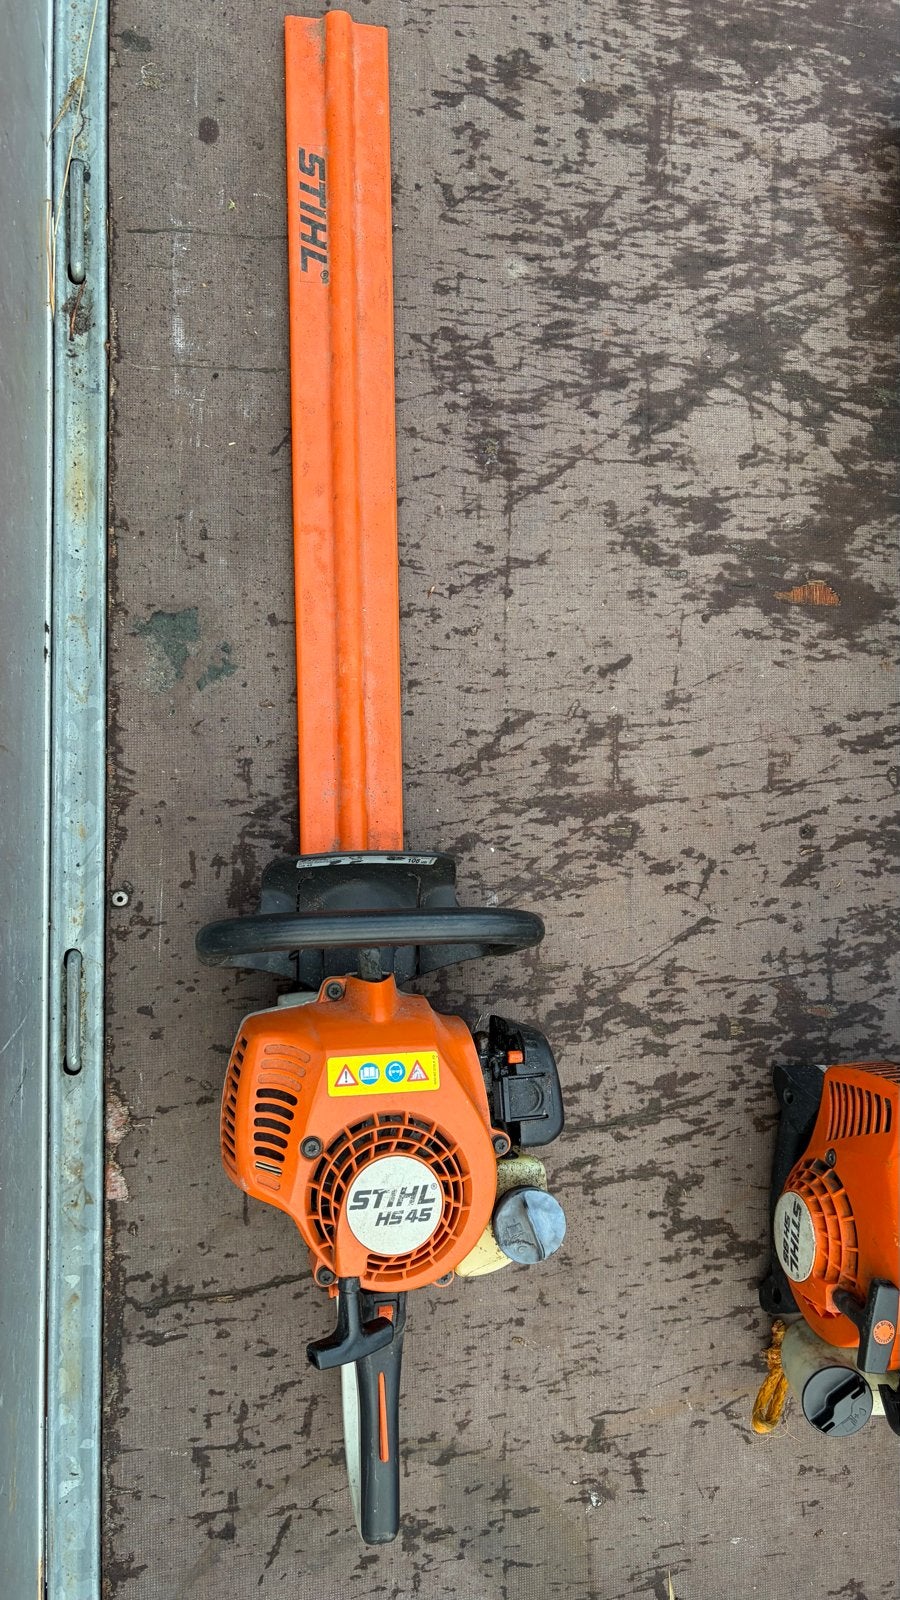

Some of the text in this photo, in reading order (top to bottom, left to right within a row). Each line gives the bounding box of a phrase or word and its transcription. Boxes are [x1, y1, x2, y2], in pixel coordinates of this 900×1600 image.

[299, 147, 327, 273] STIHL
[349, 1185, 436, 1210] STIHL
[375, 1207, 433, 1227] HS 45
[788, 1199, 802, 1272] STIHL
